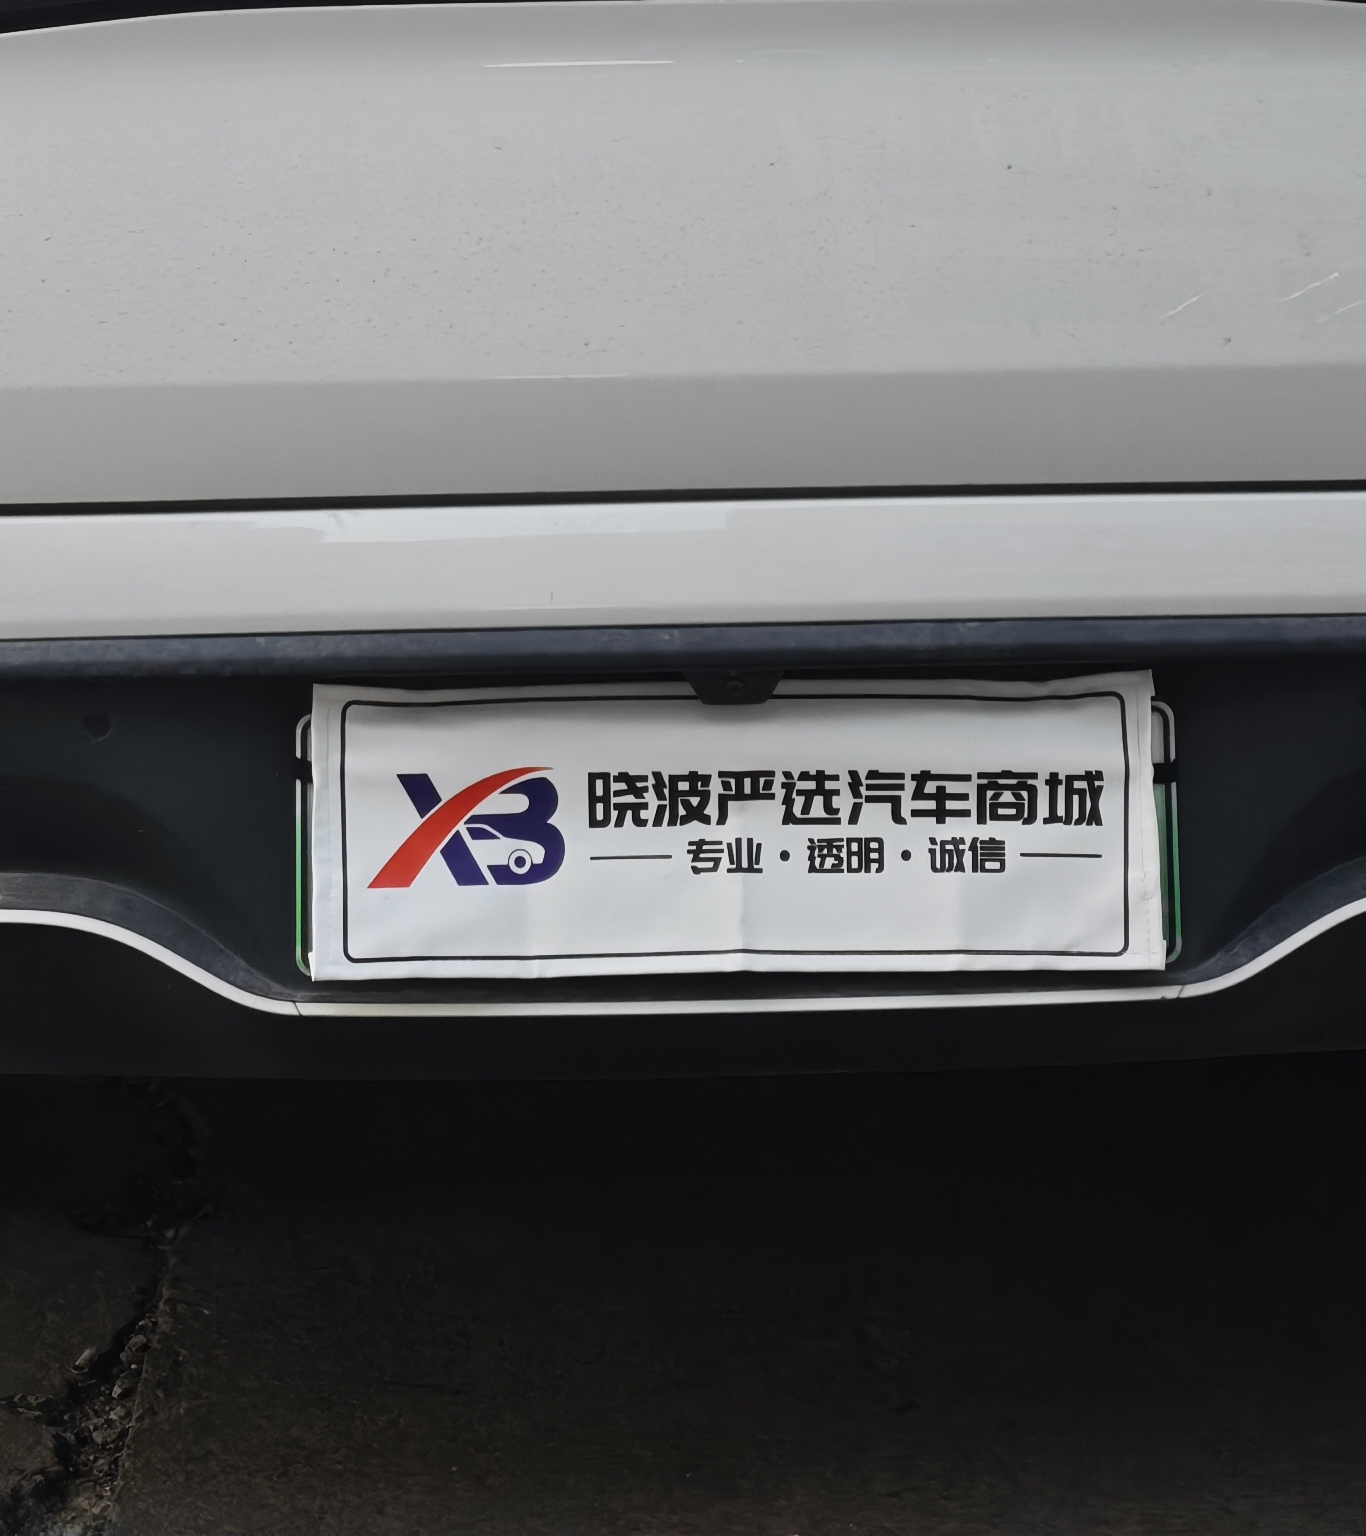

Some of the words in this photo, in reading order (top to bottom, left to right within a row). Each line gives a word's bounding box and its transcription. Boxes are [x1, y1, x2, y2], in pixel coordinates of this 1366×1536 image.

[586, 769, 1105, 829] 晓波严选汽车商城
